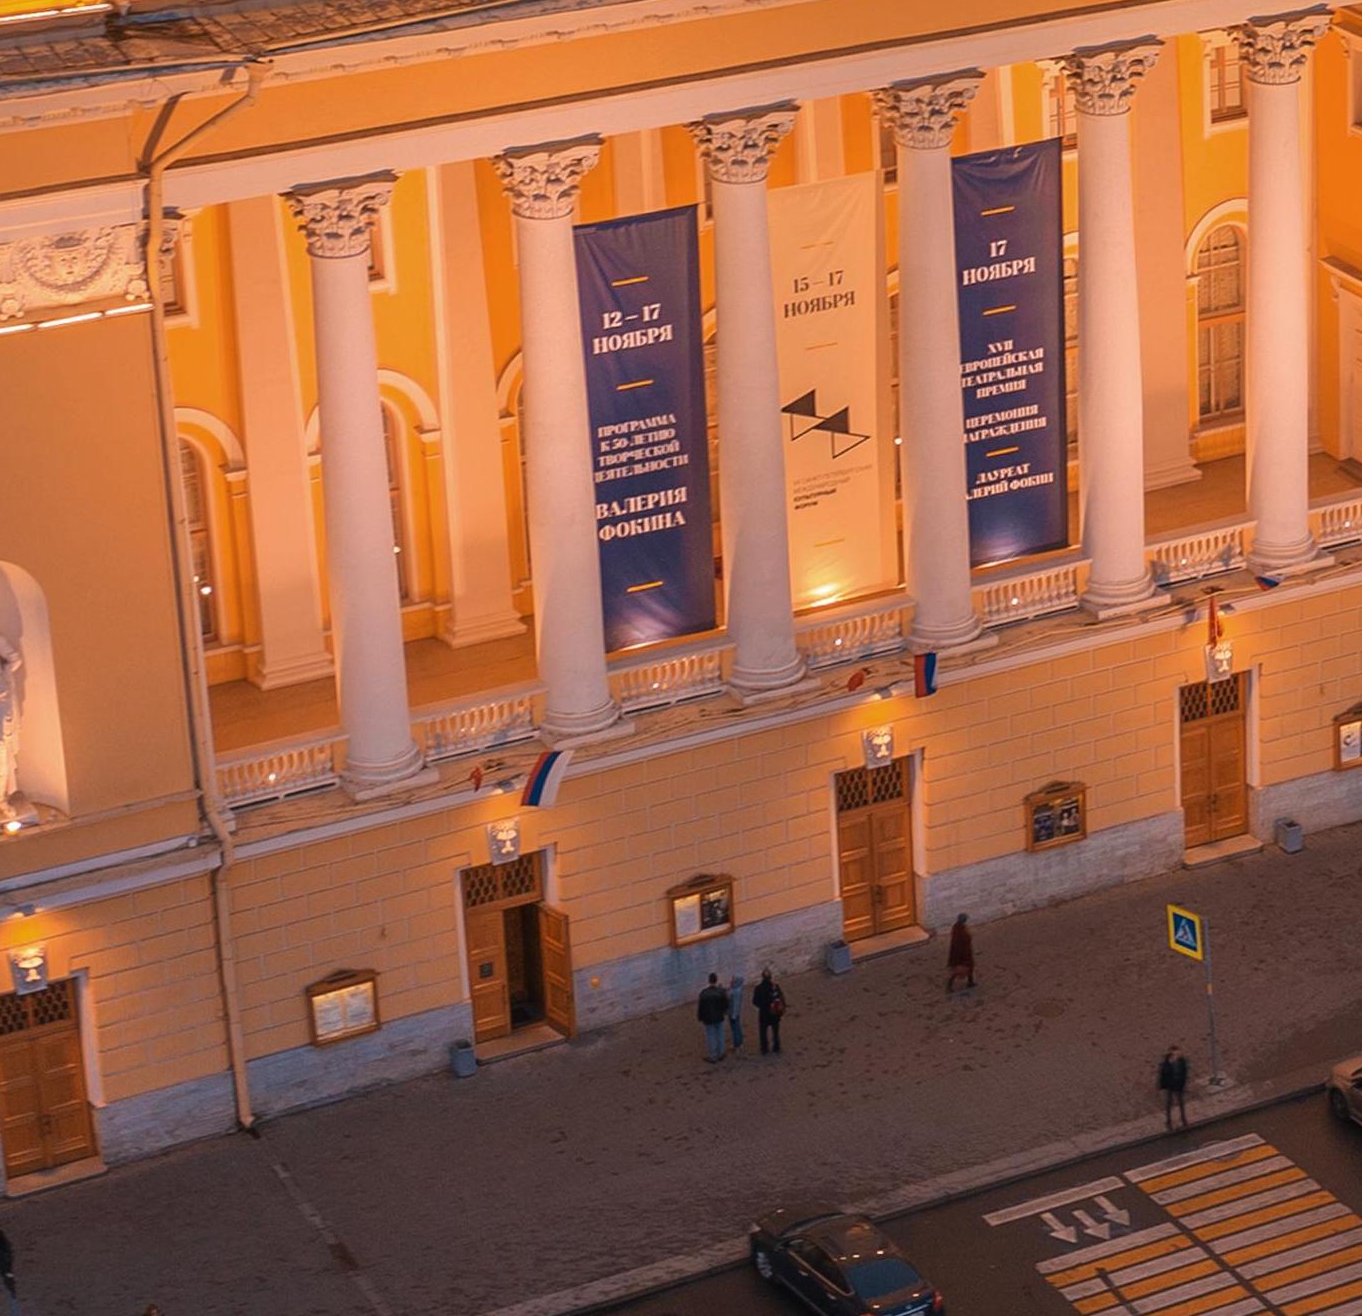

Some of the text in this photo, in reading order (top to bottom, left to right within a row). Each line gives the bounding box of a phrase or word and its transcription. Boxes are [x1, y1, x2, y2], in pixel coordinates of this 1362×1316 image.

[989, 239, 1007, 258] 17
[793, 277, 810, 294] 15
[828, 269, 844, 287] 17
[962, 256, 1036, 286] НОЯБРЯ
[602, 311, 623, 330] 12
[642, 303, 662, 322] 17
[784, 290, 855, 319] НОЯБРЯ
[592, 324, 673, 355] НОЯБРЯ
[961, 361, 1043, 389] ТЕАТРАЛЬНАЯ
[976, 378, 1027, 399] ПРЕМИЯ
[597, 412, 676, 439] ПРОГРАММА
[965, 403, 1039, 430] ЦЕРЕМОНИЯ
[598, 438, 680, 468] ТВОРЧЕСКОЙ
[600, 440, 611, 453] К
[976, 462, 1031, 485] ЛАУРЕАТ
[1009, 471, 1054, 490] ФОКИН
[595, 485, 688, 521] ВАЛЕРИЯ
[598, 509, 687, 542] ФОКИНА
